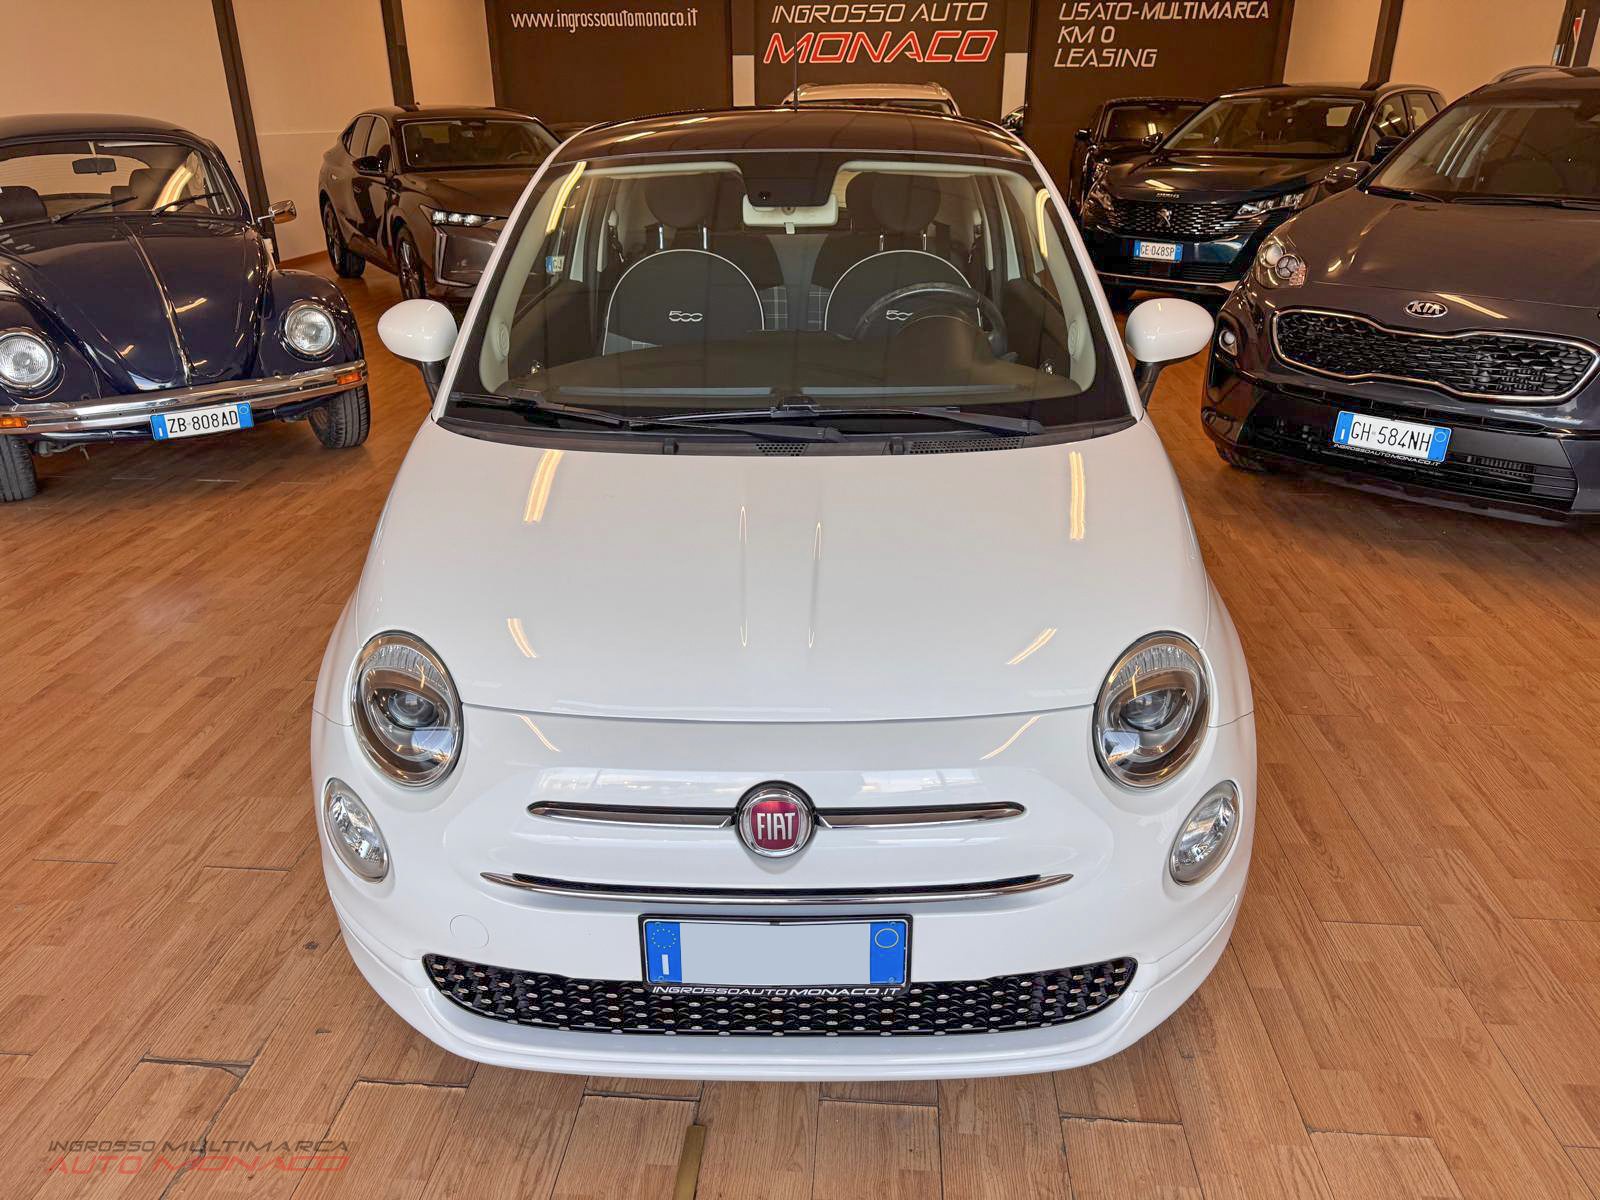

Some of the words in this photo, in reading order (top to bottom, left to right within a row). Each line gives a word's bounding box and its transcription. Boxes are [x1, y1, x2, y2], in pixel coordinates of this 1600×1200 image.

[511, 8, 698, 34] www.ingrossoautomonaco.it
[771, 4, 906, 23] INGROSSO
[910, 2, 989, 22] AUTO
[1058, 1, 1269, 20] USATO-MULTIMARCA
[1057, 26, 1095, 43] KM
[763, 30, 998, 63] MONACO
[1053, 48, 1158, 67] LEASING
[669, 310, 702, 322] 500
[167, 417, 187, 433] ZB
[191, 410, 238, 431] 808AD
[1351, 421, 1372, 442] GH
[1377, 426, 1431, 452] 584NH
[756, 812, 795, 840] FIAT
